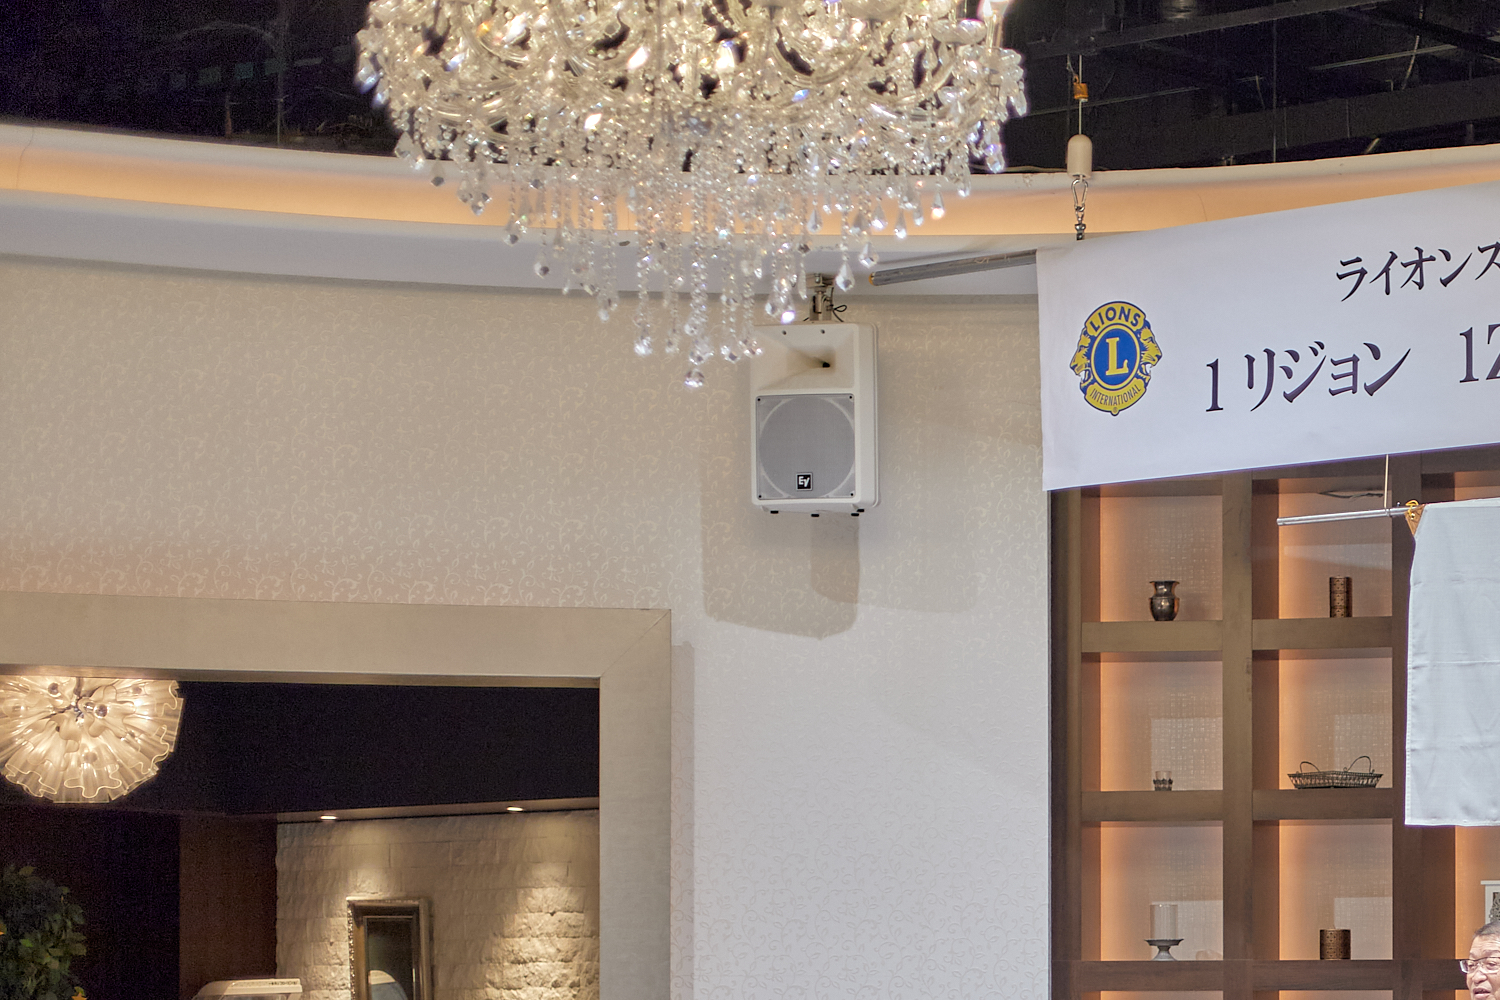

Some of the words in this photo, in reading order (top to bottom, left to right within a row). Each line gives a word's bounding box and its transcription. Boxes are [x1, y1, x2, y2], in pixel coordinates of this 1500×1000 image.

[1089, 306, 1141, 332] LIONS
[1105, 337, 1129, 376] L
[1089, 384, 1141, 407] INTERNATIONAL
